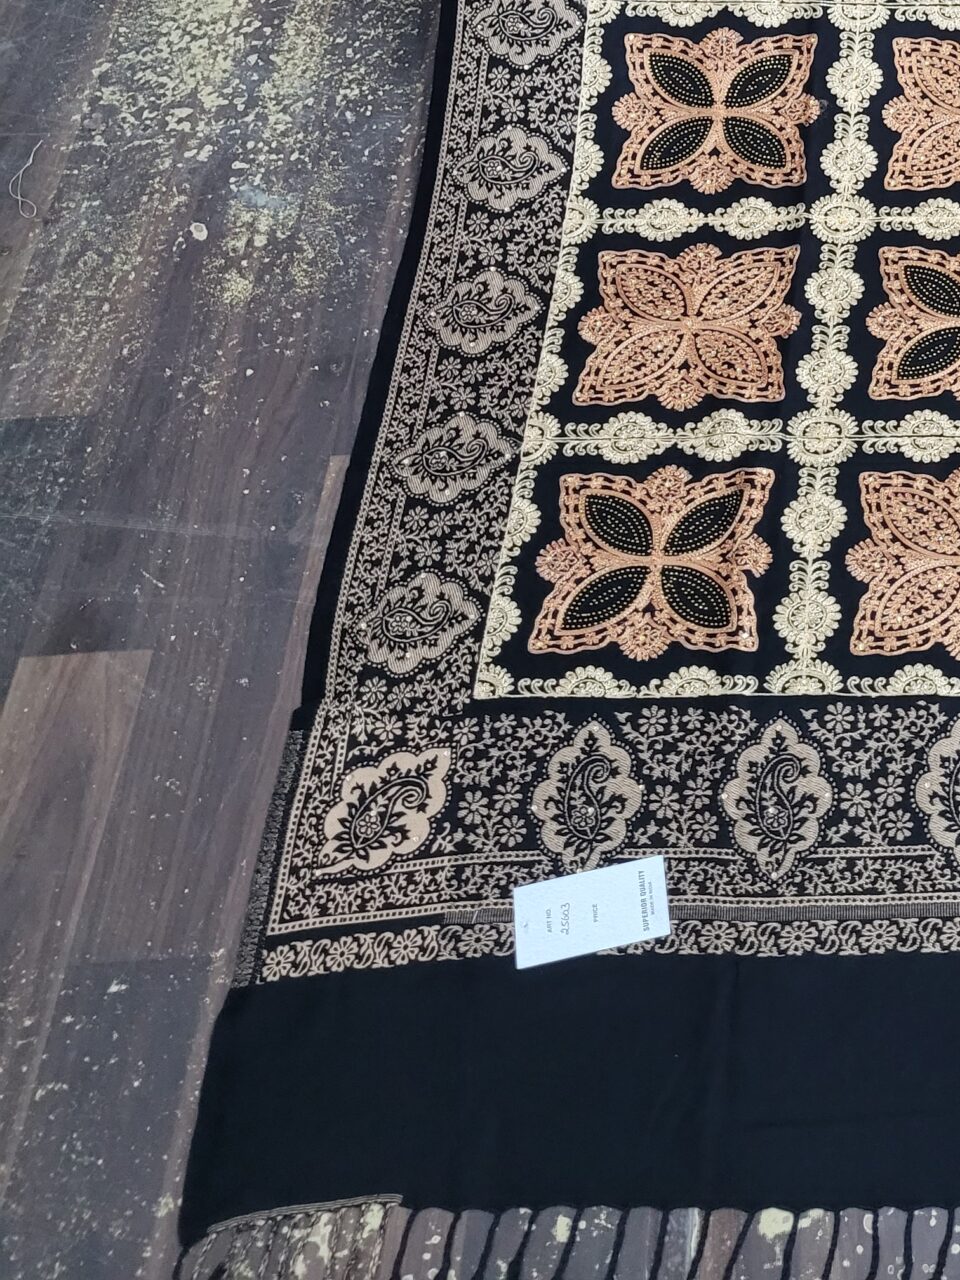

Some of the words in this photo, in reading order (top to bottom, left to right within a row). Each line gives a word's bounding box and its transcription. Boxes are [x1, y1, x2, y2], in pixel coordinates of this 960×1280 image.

[638, 870, 647, 897] QUALITY
[560, 902, 570, 935] 25603
[640, 897, 650, 932] SUPERIOR
